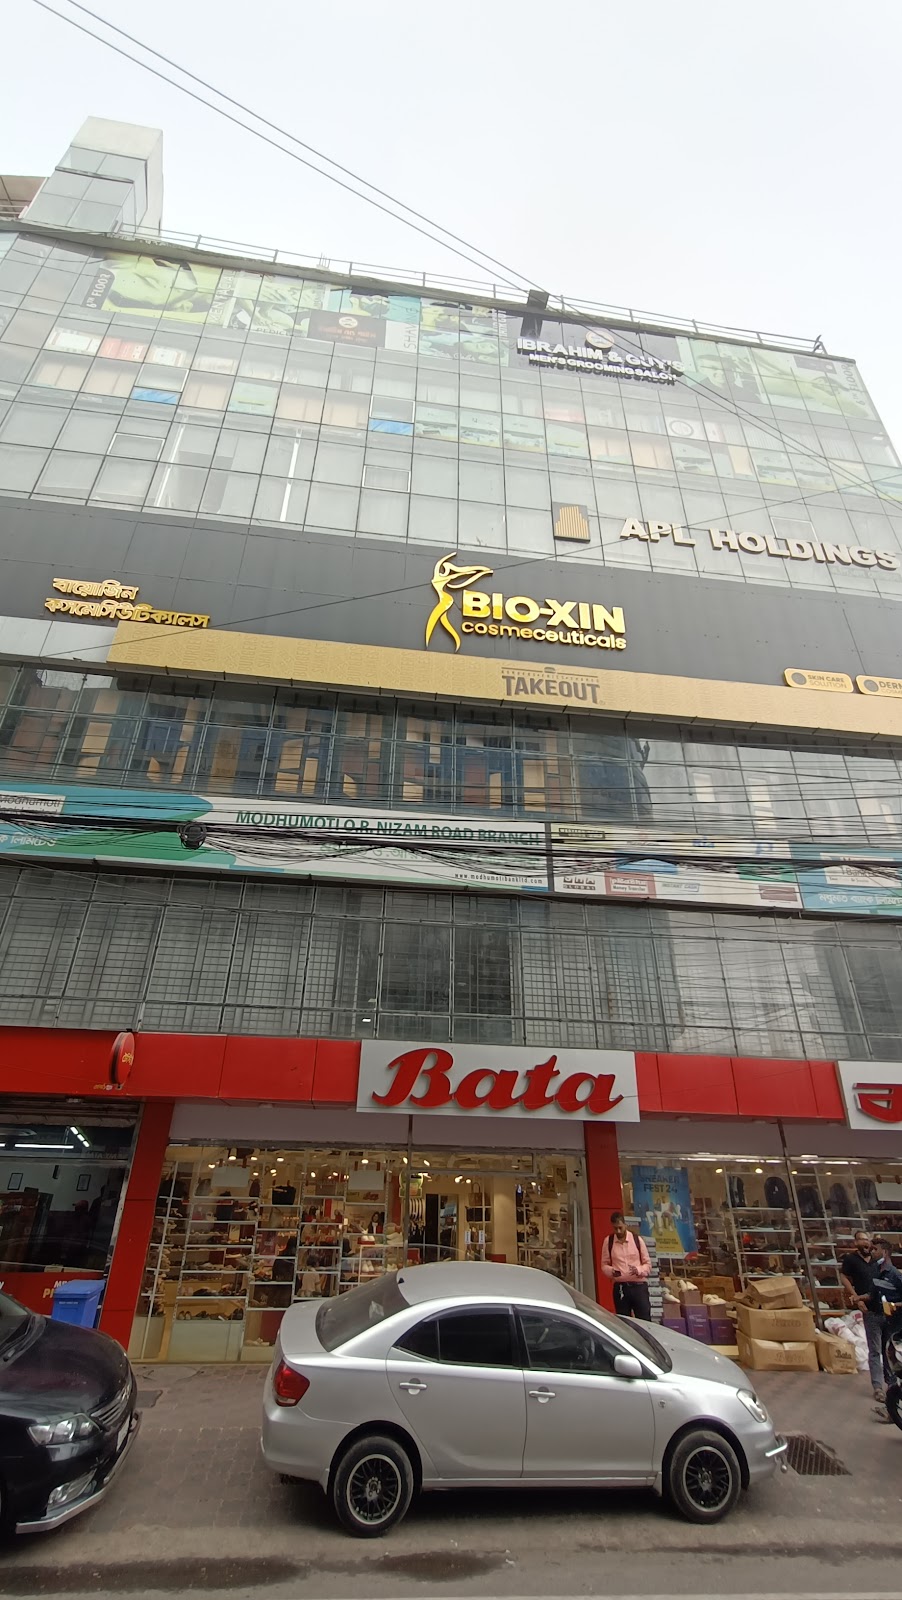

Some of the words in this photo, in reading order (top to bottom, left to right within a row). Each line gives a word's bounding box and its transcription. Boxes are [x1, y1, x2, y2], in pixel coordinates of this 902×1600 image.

[516, 338, 604, 361] IBRAHIM
[607, 351, 623, 364] &
[625, 353, 685, 373] GUY'S
[565, 358, 634, 375] GROOMING
[619, 517, 696, 548] APL
[709, 527, 901, 571] HOLDINGS
[462, 589, 626, 634] BIO-XIN
[461, 621, 627, 650] cosmeceuticals
[501, 675, 601, 705] TAKEOUT
[809, 680, 848, 689] SOLUTION
[235, 810, 340, 830] MODHUMOTI
[377, 821, 427, 838] NIZAM
[431, 825, 474, 841] ROAD
[371, 1047, 625, 1115] Bata
[643, 1183, 665, 1193] FEST
